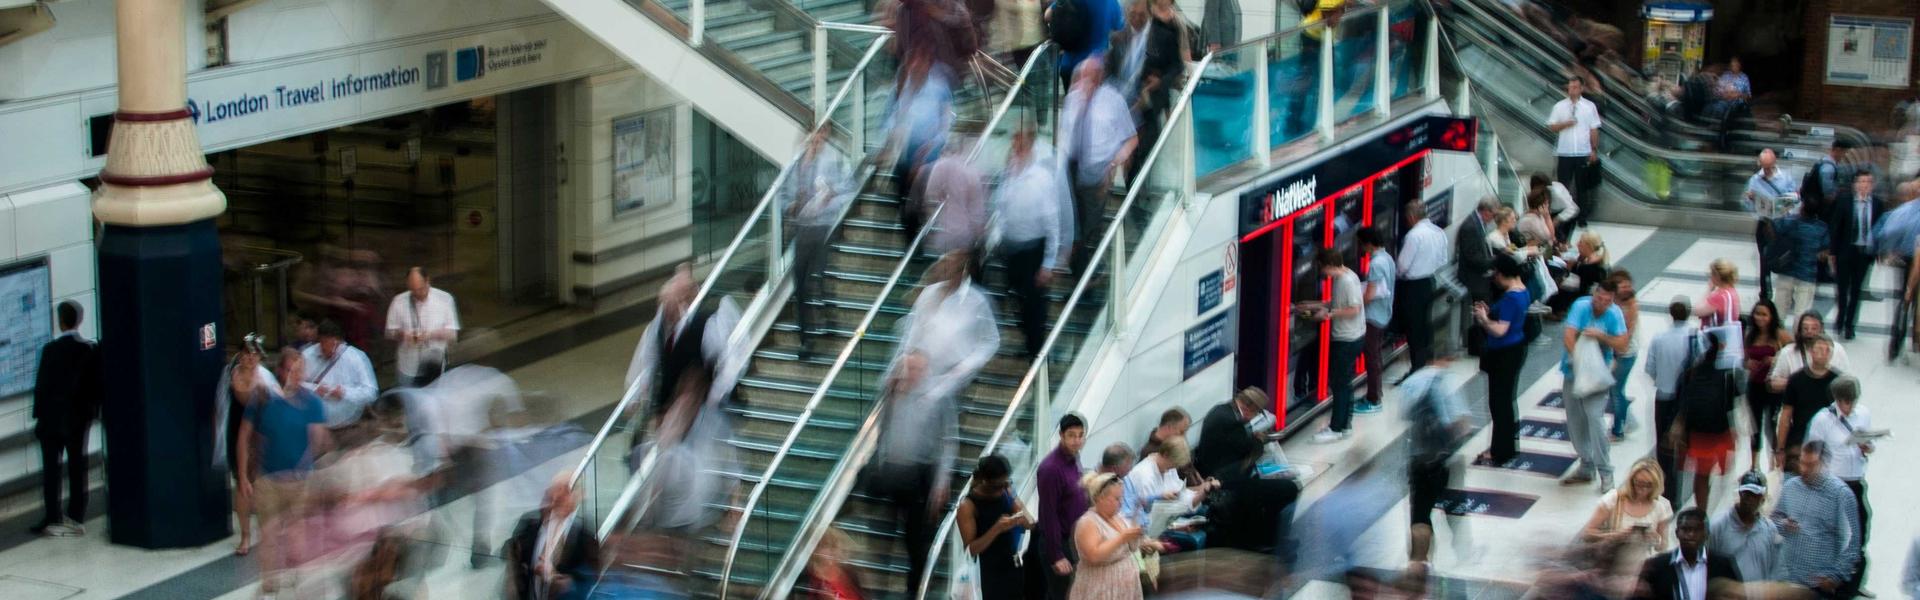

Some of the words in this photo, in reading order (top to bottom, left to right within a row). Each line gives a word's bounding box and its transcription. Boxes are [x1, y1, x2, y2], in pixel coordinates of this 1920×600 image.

[207, 93, 268, 122] London
[276, 81, 324, 107] Travel
[332, 66, 420, 99] Information
[1275, 174, 1317, 219] NatWest
